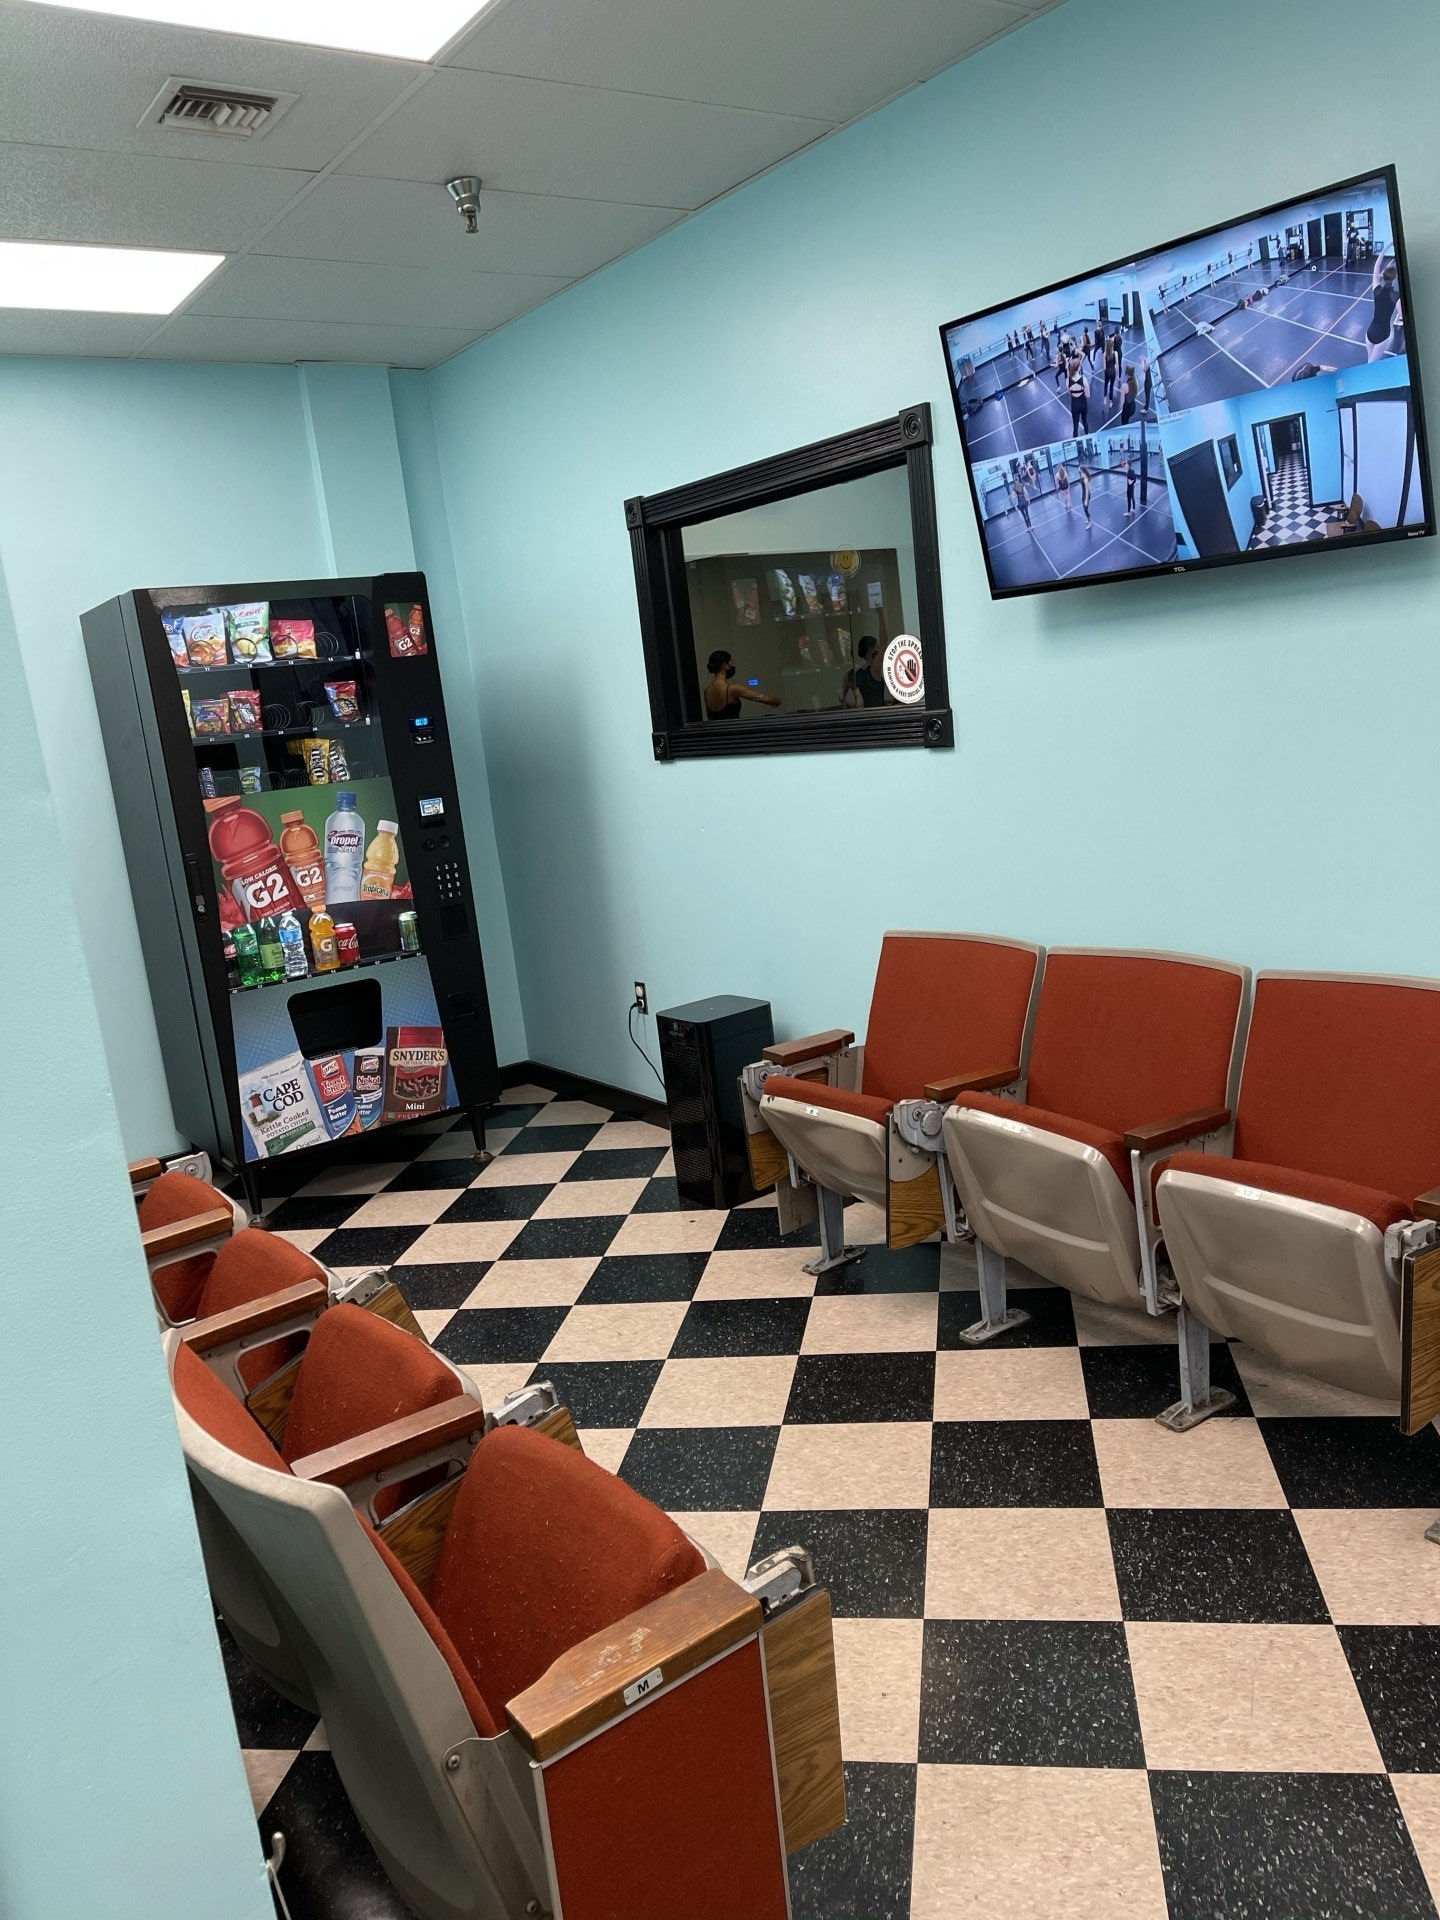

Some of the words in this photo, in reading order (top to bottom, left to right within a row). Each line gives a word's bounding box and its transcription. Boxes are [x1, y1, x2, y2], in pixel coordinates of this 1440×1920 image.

[410, 627, 421, 636] G2
[398, 637, 413, 651] G2
[888, 644, 898, 661] STOP
[897, 639, 907, 647] THE
[330, 836, 359, 846] propel
[240, 875, 255, 885] LOW
[254, 864, 279, 880] CALORIE
[296, 866, 323, 887] G2
[246, 873, 290, 909] G2
[362, 884, 389, 896] Tropicana
[320, 938, 333, 952] G
[392, 1050, 445, 1062] SNYDER'S
[321, 1075, 346, 1088] Toast
[263, 1079, 301, 1102] CAPE
[324, 1082, 347, 1096] Chee
[272, 1090, 304, 1112] COD
[405, 1102, 425, 1110] Mini
[327, 1103, 348, 1115] Peanut
[329, 1110, 348, 1121] Butter
[260, 1121, 283, 1135] Kettle
[283, 1108, 310, 1124] Cooked
[266, 1125, 290, 1138] POTATO
[290, 1116, 308, 1128] CHIPS
[637, 1680, 649, 1694] M
